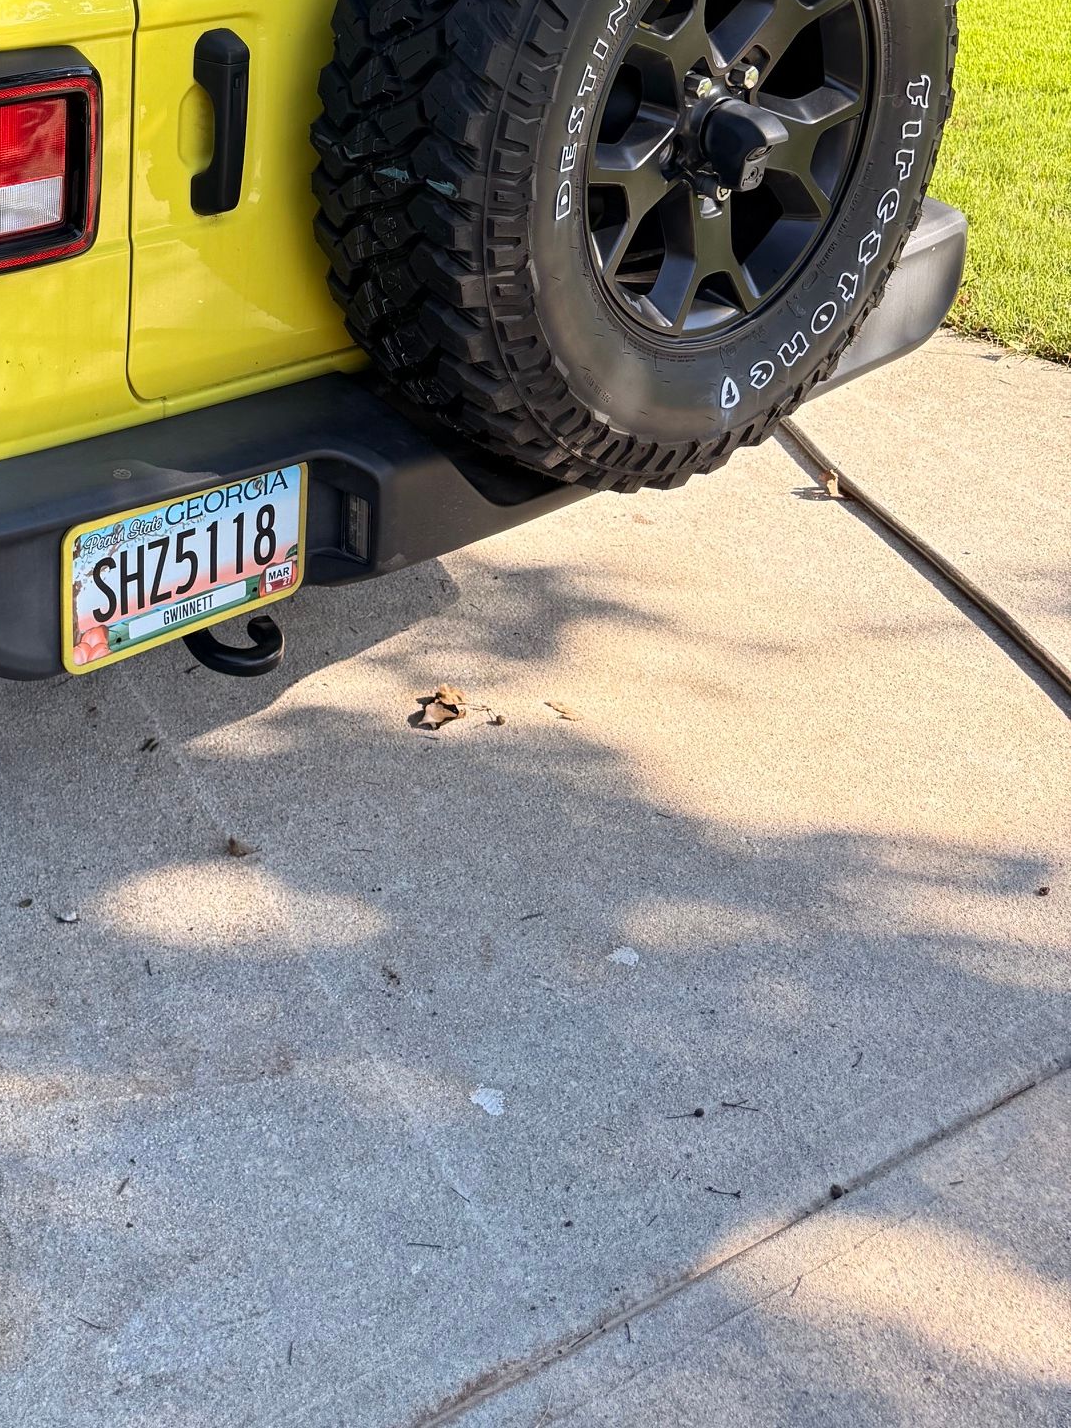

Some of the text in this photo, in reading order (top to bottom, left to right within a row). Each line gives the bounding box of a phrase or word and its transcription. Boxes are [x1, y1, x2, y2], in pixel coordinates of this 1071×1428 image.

[83, 470, 289, 554] Peach State GEORGIA
[92, 503, 277, 623] SHZ5118
[268, 567, 290, 581] MAR
[163, 594, 214, 625] GWINNETT
